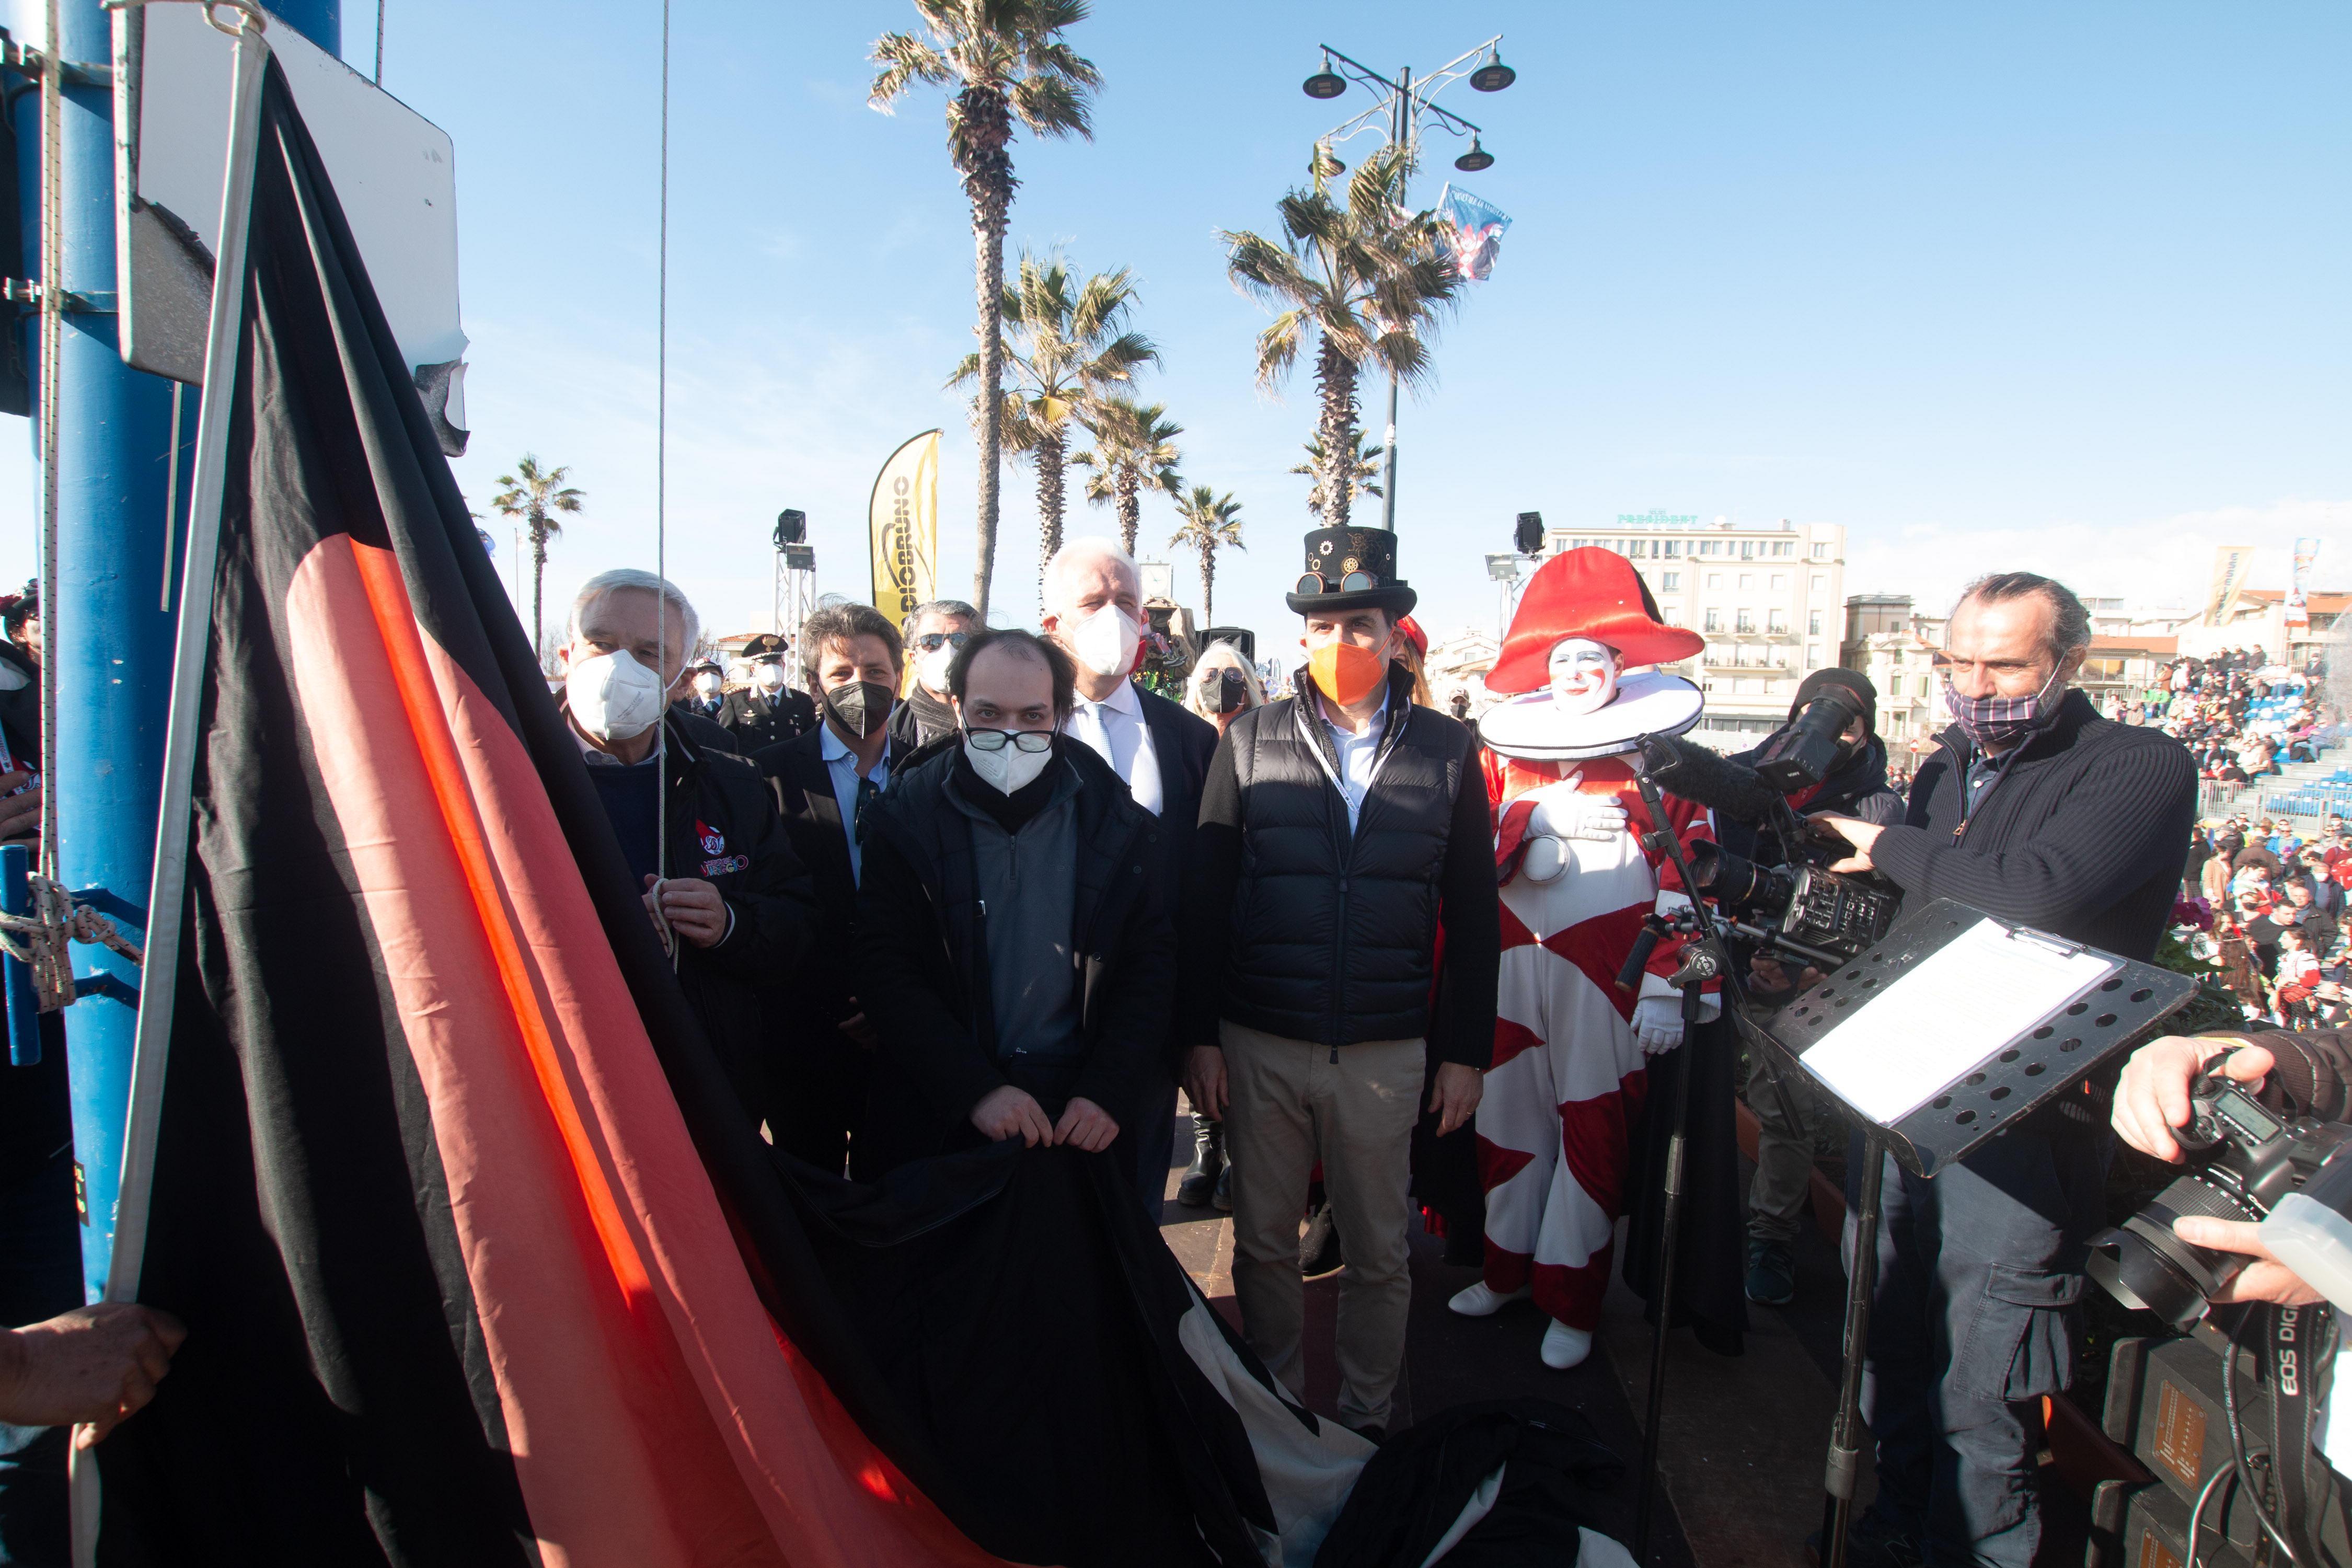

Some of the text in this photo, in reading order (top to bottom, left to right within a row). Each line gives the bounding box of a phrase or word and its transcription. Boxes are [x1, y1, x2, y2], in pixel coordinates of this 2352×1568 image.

[1451, 190, 1509, 222] CARNEVALE DI VIAREGGIO
[1617, 514, 1698, 524] PRESIDENT
[1697, 956, 1714, 976] K&M
[2280, 1349, 2299, 1396] EOS
